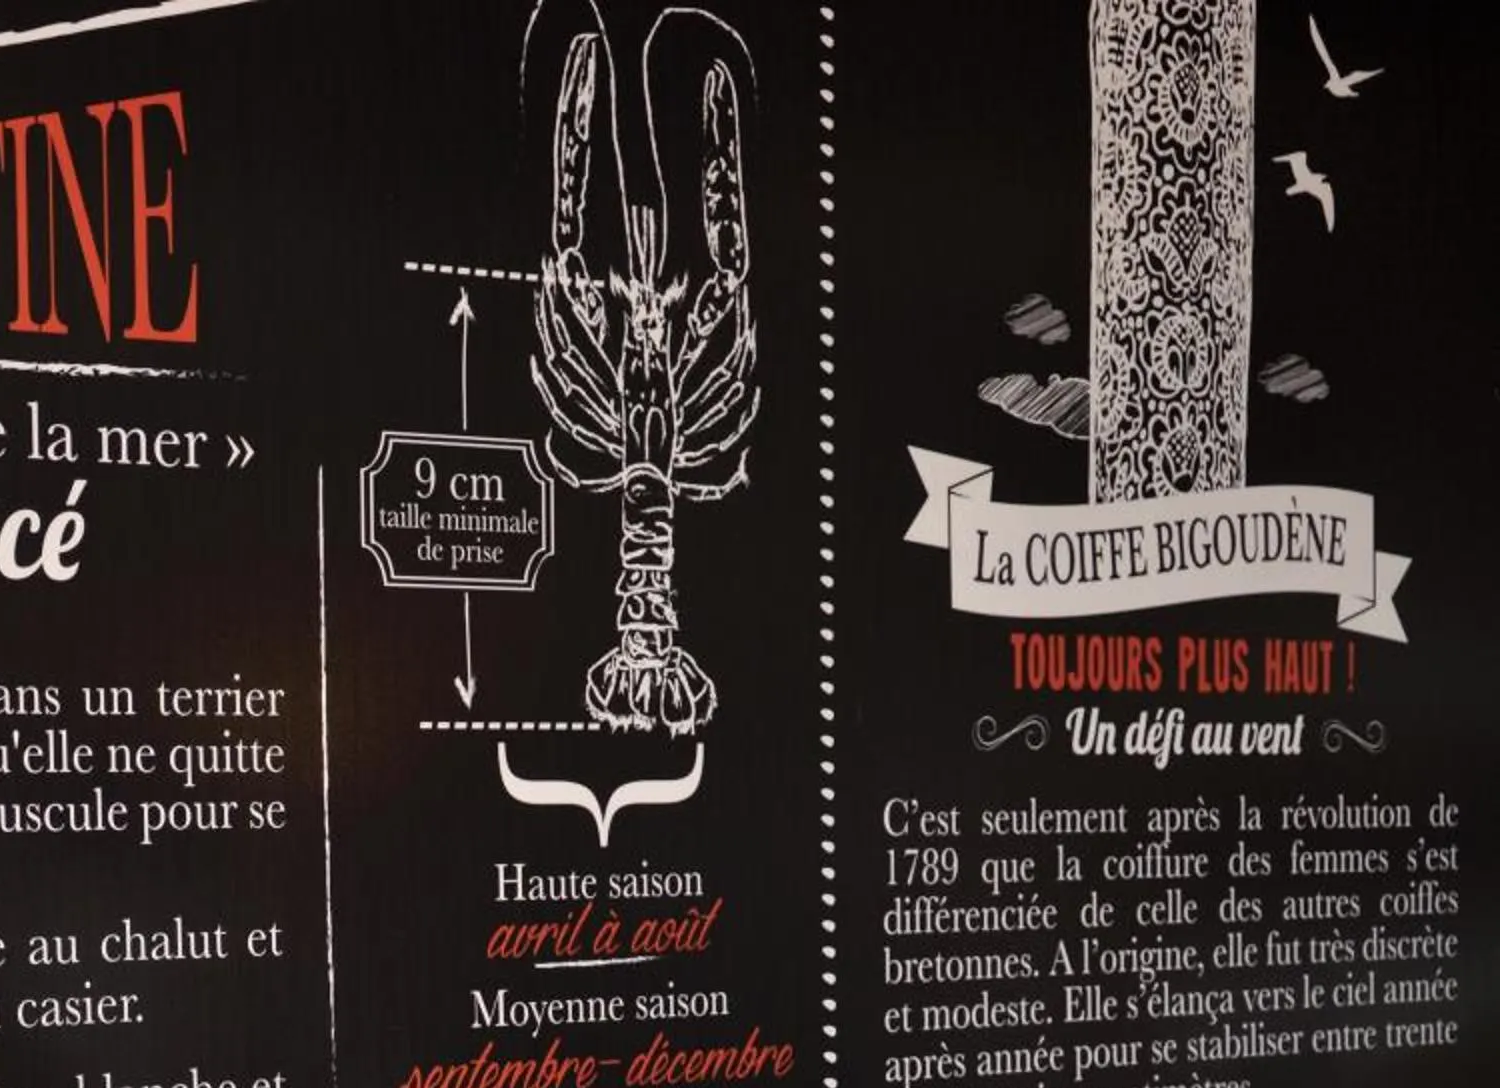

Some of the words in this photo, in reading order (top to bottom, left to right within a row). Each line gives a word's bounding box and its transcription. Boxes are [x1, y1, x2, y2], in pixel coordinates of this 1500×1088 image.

[28, 402, 78, 462] la
[98, 427, 207, 467] mer
[415, 458, 435, 498] 9
[450, 474, 504, 501] cm
[380, 503, 431, 528] taille
[440, 506, 538, 533] minimale
[975, 530, 1014, 585] La
[1026, 526, 1147, 586] COIFFE
[1154, 497, 1346, 573] BIGOUDÈNE
[418, 536, 443, 560] de
[452, 538, 503, 570] prise
[1012, 634, 1161, 690] TOUJOURS
[1179, 637, 1248, 692] PLUS
[1266, 641, 1332, 692] HAUT
[82, 688, 136, 715] un
[158, 674, 284, 716] terrier
[108, 745, 155, 773] ne
[170, 730, 284, 787] quitte
[1066, 707, 1116, 755] Un
[1125, 708, 1184, 769] défi
[1192, 723, 1233, 755] au
[1241, 715, 1303, 754] vent
[140, 802, 238, 844] pour
[250, 802, 285, 828] se
[884, 798, 959, 836] C'est
[982, 798, 1126, 834] seulement
[1146, 797, 1220, 845] après
[1240, 796, 1261, 830] la
[1283, 794, 1410, 829] révolution
[1430, 794, 1458, 825] de
[495, 864, 596, 901] Haute
[610, 861, 703, 898] saison
[888, 848, 958, 885] 1789
[982, 859, 1034, 895] que
[1058, 845, 1081, 880] la
[1103, 842, 1208, 880] coiffure
[1229, 841, 1270, 875] des
[1292, 840, 1388, 874] femmes
[1408, 838, 1456, 869] s'est
[488, 902, 592, 958] avril
[593, 910, 620, 953] à
[632, 897, 723, 953] août
[884, 894, 1057, 935] différenciée
[1081, 892, 1113, 927] de
[1137, 889, 1196, 925] celle
[1220, 887, 1261, 921] des
[1284, 895, 1359, 919] autres
[1381, 882, 1458, 915] coiffes
[29, 936, 79, 965] au
[101, 917, 227, 962] chalut
[248, 924, 282, 956] et
[884, 947, 1038, 984] bretonnes.
[1050, 941, 1073, 976] A
[1083, 936, 1204, 982] l'origine,
[1214, 933, 1257, 968] elle
[1267, 931, 1299, 965] fut
[1311, 929, 1354, 963] très
[1363, 926, 1457, 960] discrète
[17, 981, 143, 1028] casier.
[472, 990, 624, 1037] Moyenne
[636, 982, 728, 1019] saison
[885, 1005, 911, 1032] et
[923, 991, 1052, 1030] modeste.
[1065, 985, 1117, 1022] Elle
[1128, 974, 1233, 1024] s'élança
[1244, 988, 1294, 1011] vers
[1304, 975, 1324, 1008] le
[1333, 972, 1374, 1006] ciel
[1384, 969, 1457, 1003] année
[977, 1036, 1063, 1075] année
[1075, 1042, 1142, 1081] pour
[1152, 1040, 1176, 1063] se
[1188, 1022, 1303, 1060] stabiliser
[1313, 1027, 1376, 1052] entre
[1387, 1022, 1456, 1047] trente
